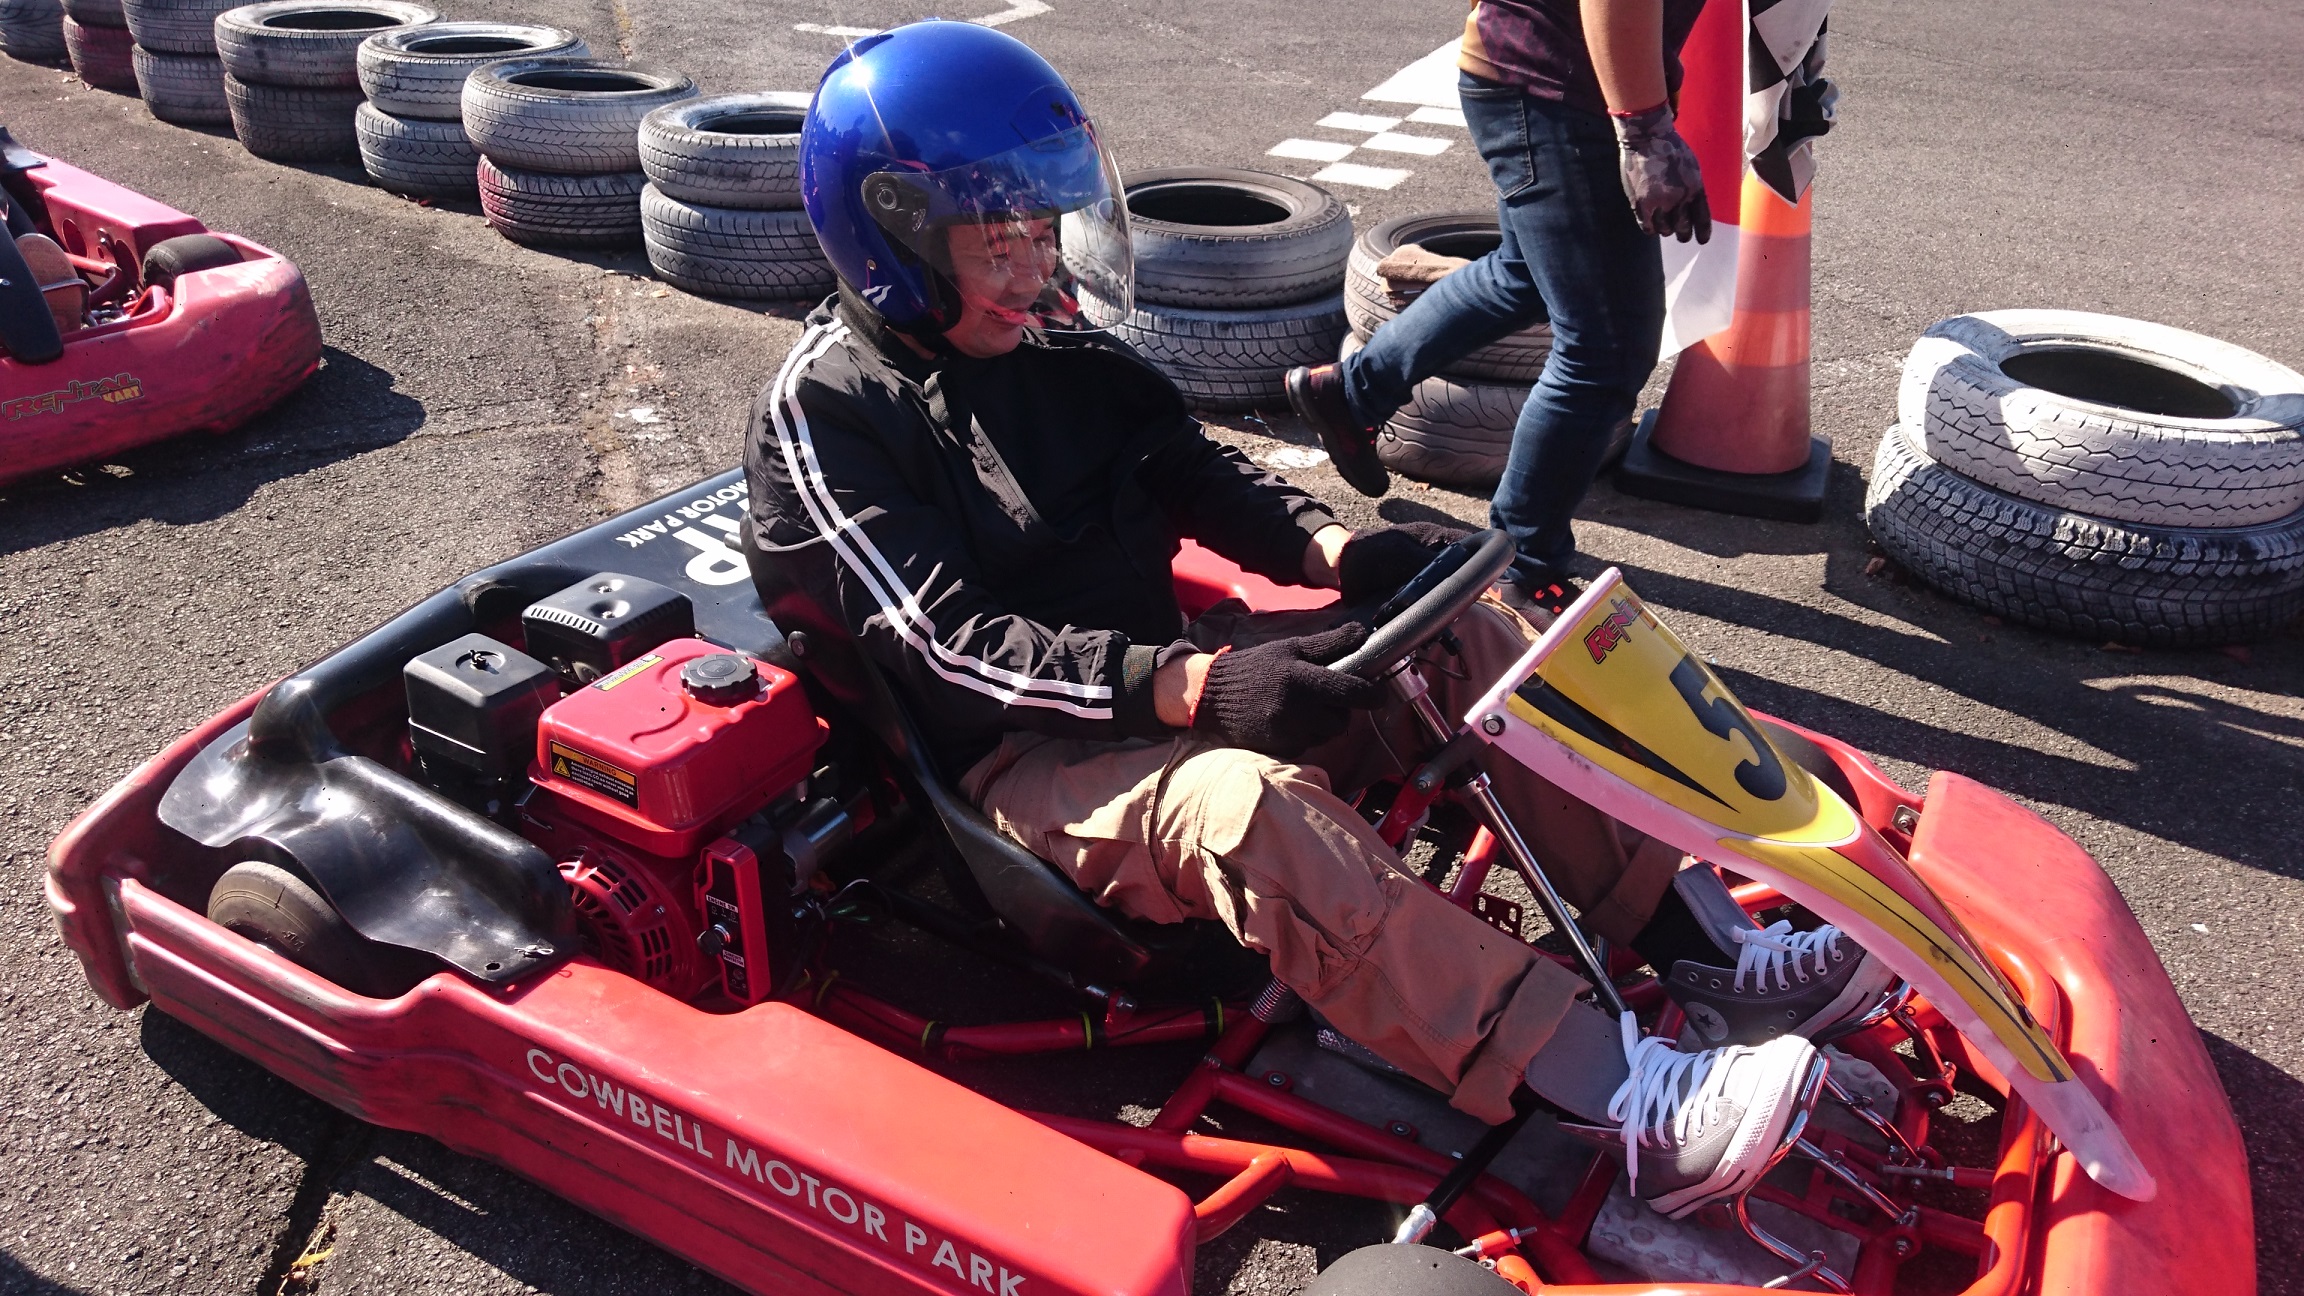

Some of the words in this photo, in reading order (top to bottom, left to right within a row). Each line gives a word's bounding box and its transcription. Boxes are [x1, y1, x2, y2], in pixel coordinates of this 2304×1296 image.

[2, 372, 141, 421] RENTAL
[102, 385, 141, 404] KART
[615, 514, 684, 548] PARK
[1669, 653, 1787, 801] 5
[583, 756, 617, 776] WARNING
[527, 1048, 713, 1159] COWBELL
[726, 1138, 889, 1243] MOTOR
[904, 1221, 1026, 1296] PARK
